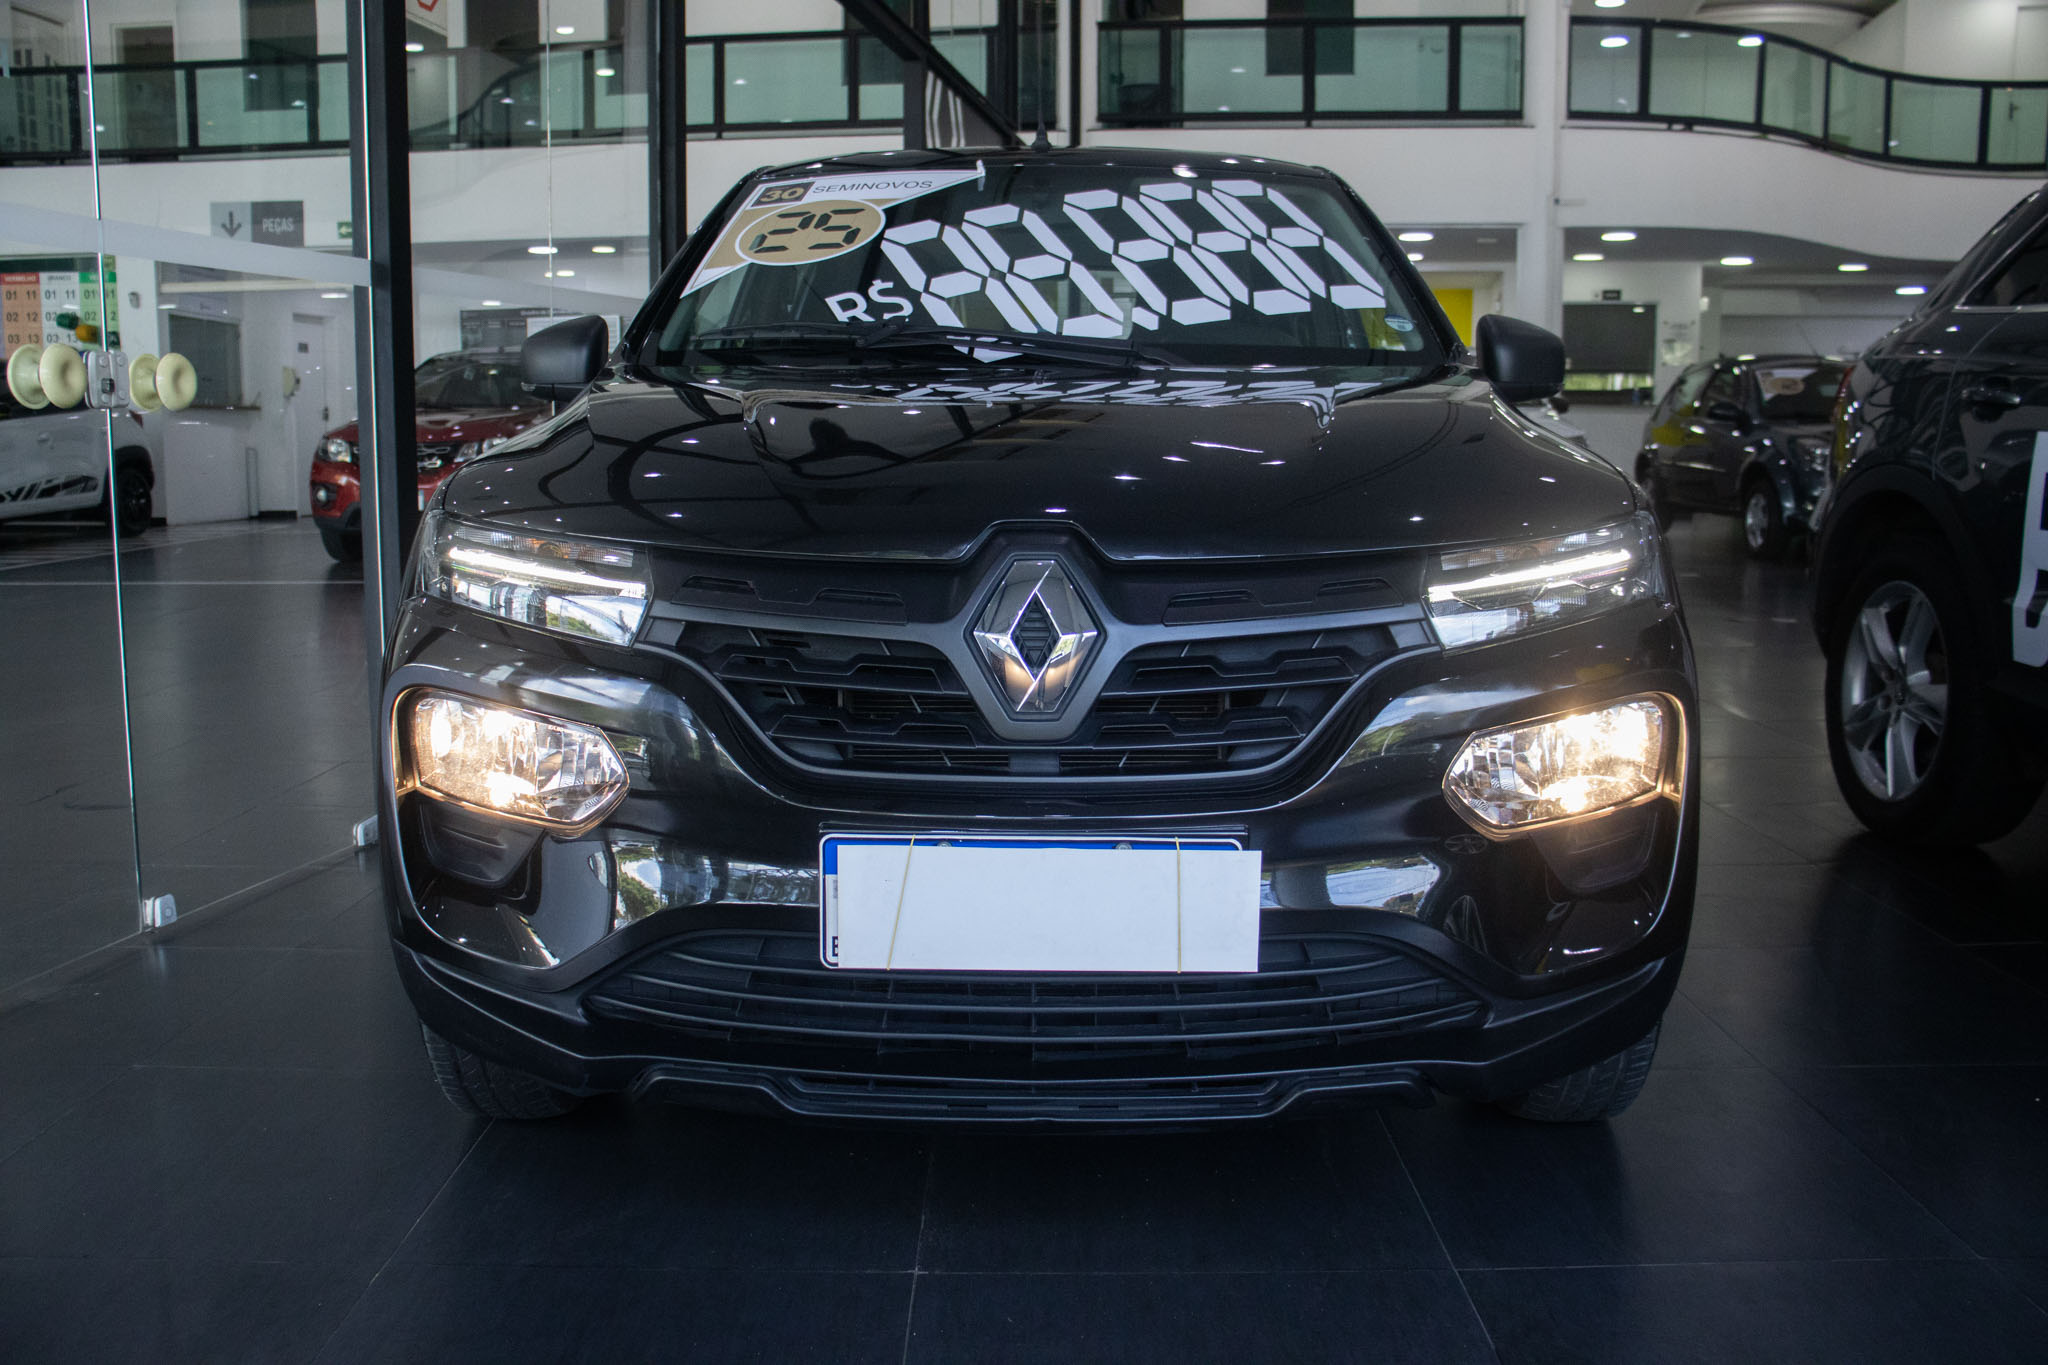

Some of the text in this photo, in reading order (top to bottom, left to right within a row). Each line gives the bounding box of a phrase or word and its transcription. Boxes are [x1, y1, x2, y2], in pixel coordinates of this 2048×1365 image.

[760, 180, 933, 202] 30 SEMINOVOS
[262, 217, 294, 234] PEÇAS
[749, 208, 866, 253] 25
[6, 290, 17, 300] 01
[26, 290, 37, 300] 11
[45, 289, 56, 300] 01
[65, 289, 76, 299] 11
[84, 289, 96, 299] 01
[825, 279, 914, 323] R$
[7, 312, 19, 322] 02
[26, 312, 38, 322] 12
[85, 312, 96, 322] 02
[8, 334, 20, 344] 03
[28, 334, 39, 344] 13
[47, 334, 59, 344] 03
